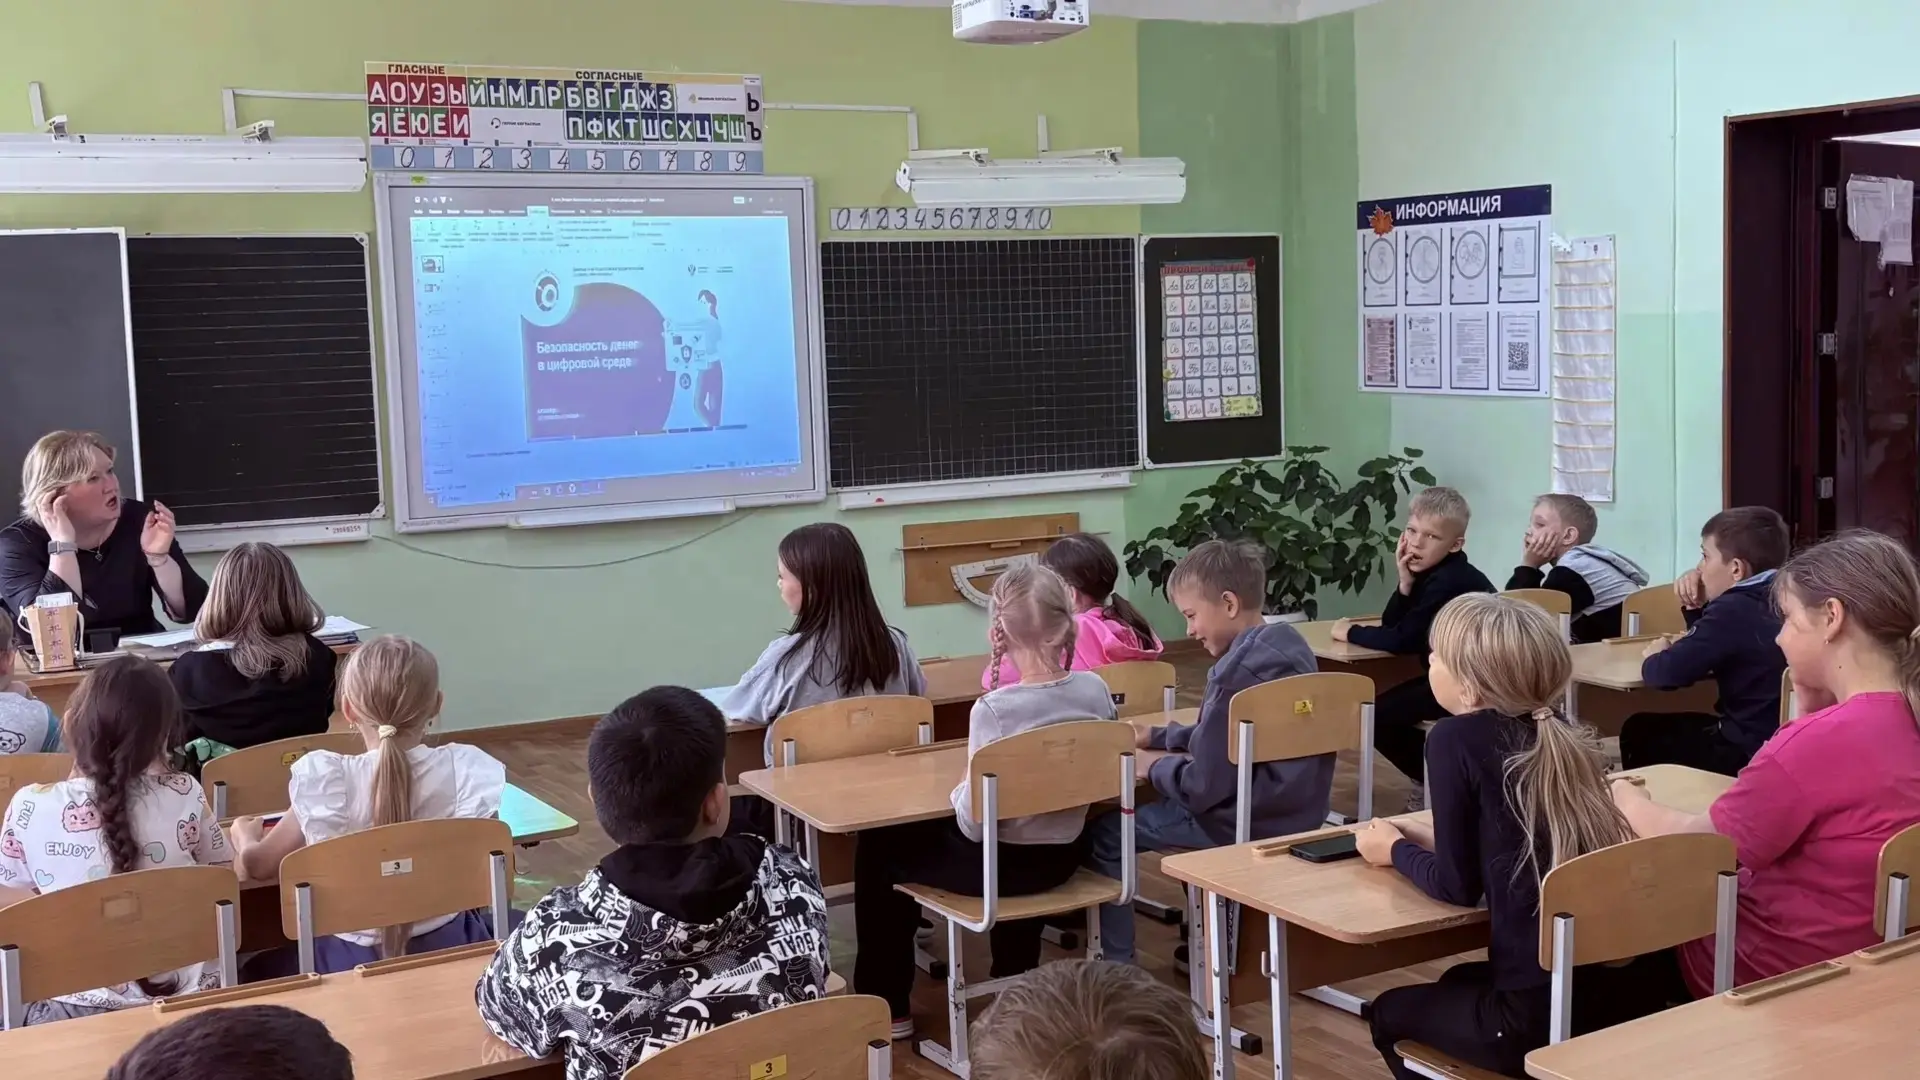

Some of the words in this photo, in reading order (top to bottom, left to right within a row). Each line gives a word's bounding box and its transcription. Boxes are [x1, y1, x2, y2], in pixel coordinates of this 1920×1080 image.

[388, 64, 445, 75] ГЛАСНЫЕ
[575, 71, 643, 81] СОГЛАСНЫЕ
[401, 146, 415, 168] 0
[444, 146, 454, 168] 1
[478, 147, 494, 169] 2
[517, 148, 531, 169] 3
[557, 148, 570, 170] 4
[591, 150, 606, 170] 5
[629, 150, 642, 170] 6
[664, 150, 678, 171] 7
[700, 150, 712, 171] 8
[734, 151, 746, 171] 9
[1396, 195, 1502, 220] ИНФОРМАЦИЯ
[536, 341, 608, 354] Безопасность
[538, 361, 545, 371] в
[547, 356, 600, 372] цифровой
[602, 357, 633, 370] среде
[16, 800, 36, 829] FUN
[208, 823, 224, 849] FUN
[45, 842, 96, 858] ENJOY
[394, 861, 401, 870] 3
[767, 914, 809, 938] TIME
[769, 932, 816, 959] GOAL
[765, 1062, 773, 1074] 3
